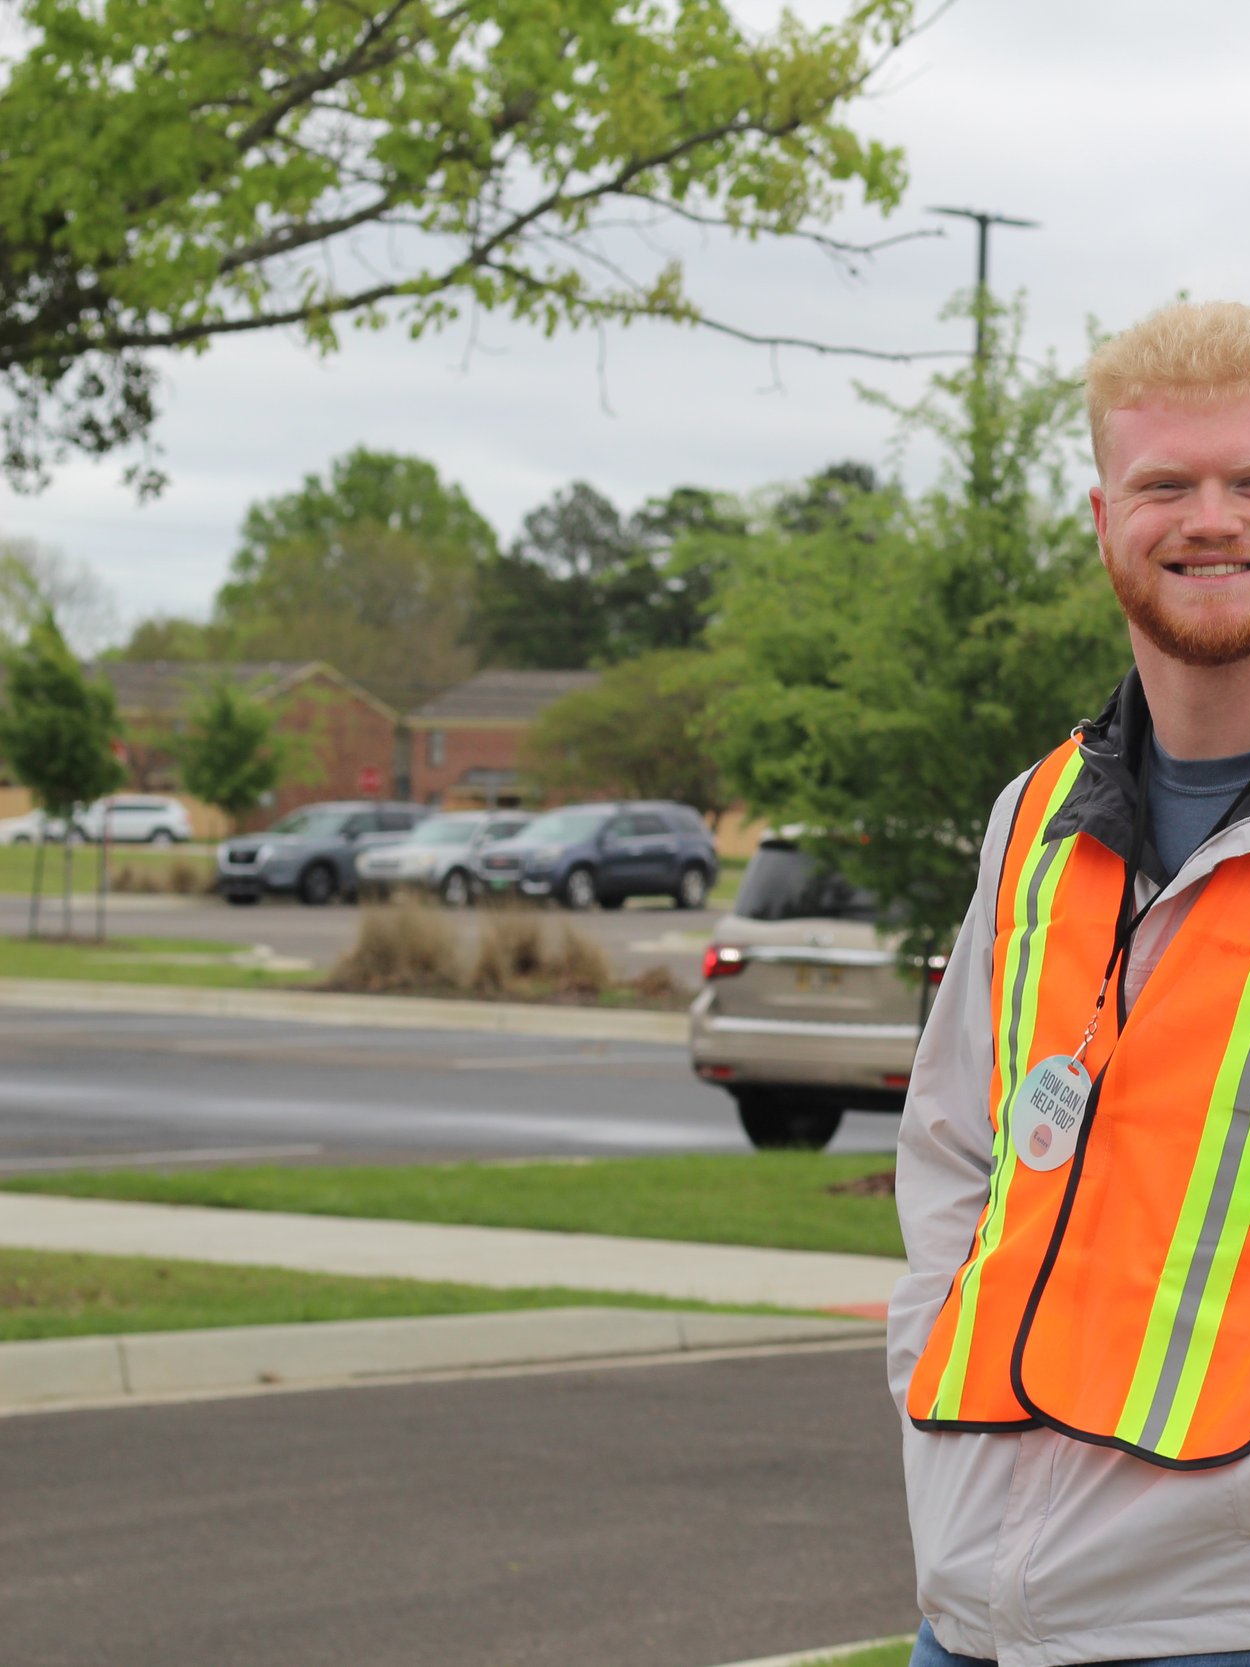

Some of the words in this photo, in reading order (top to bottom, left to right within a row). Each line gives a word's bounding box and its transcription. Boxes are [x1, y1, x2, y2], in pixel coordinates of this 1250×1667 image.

[1030, 1087, 1055, 1115] HELP
[1051, 1104, 1076, 1133] YOU?
[1039, 1069, 1064, 1096] HOW
[1060, 1086, 1082, 1112] CAN
[1076, 1099, 1086, 1116] I
